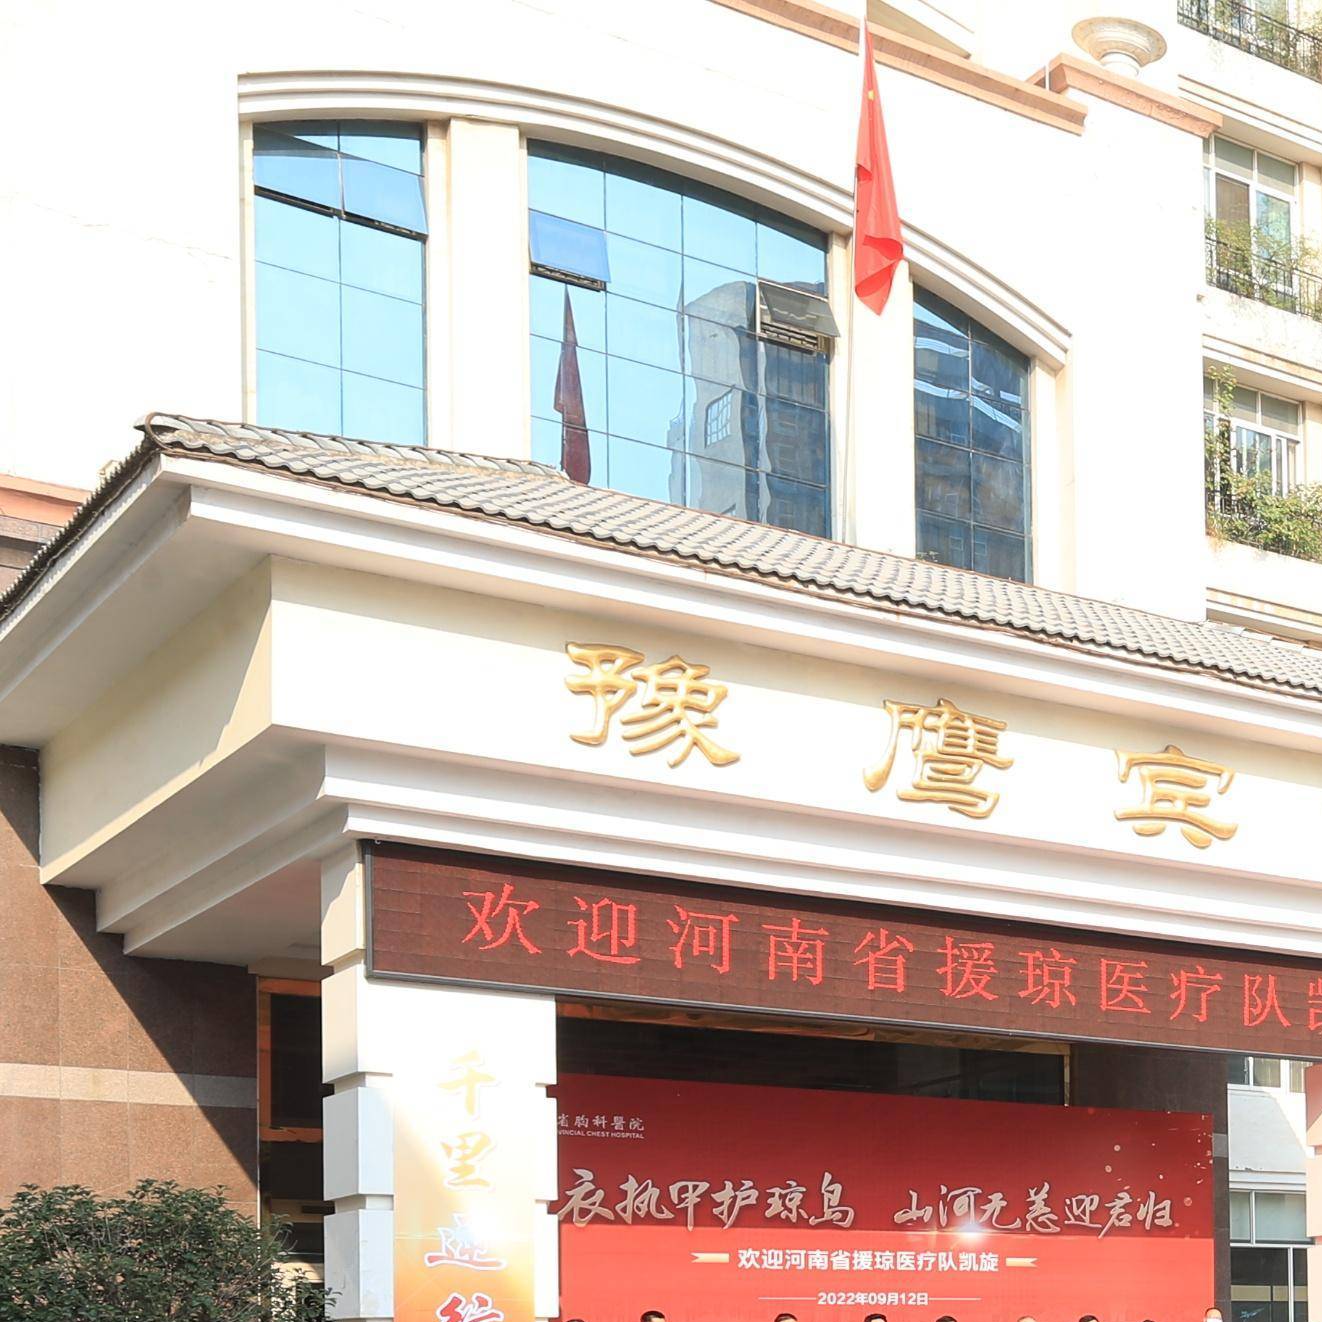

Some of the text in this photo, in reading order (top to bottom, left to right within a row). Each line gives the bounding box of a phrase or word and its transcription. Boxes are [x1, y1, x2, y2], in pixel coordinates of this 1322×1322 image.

[737, 1248, 999, 1272] 欢迎河南省援琼医疗队凯旋
[817, 1292, 929, 1306] 2022年09月12日
